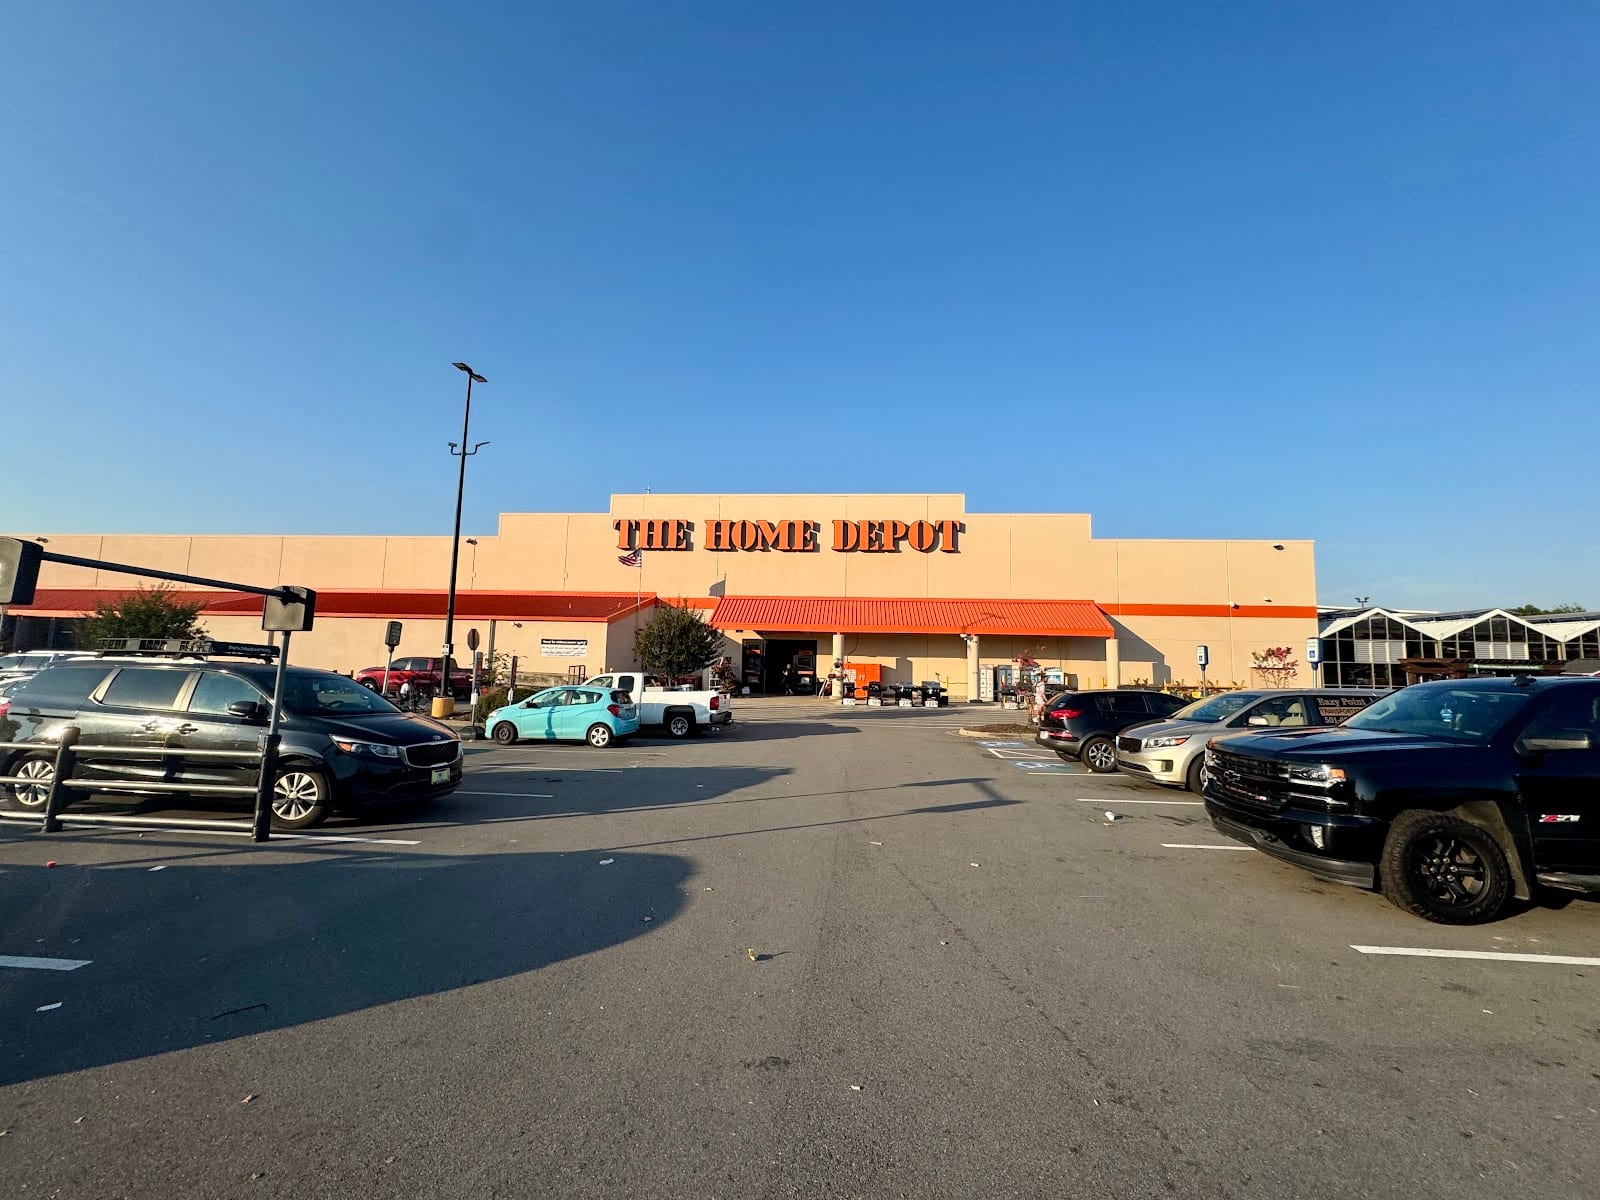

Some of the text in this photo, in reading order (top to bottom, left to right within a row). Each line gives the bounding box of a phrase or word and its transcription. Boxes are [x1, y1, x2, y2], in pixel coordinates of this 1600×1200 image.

[613, 519, 963, 552] THE HOME DEPOT
[1340, 698, 1366, 706] Point
